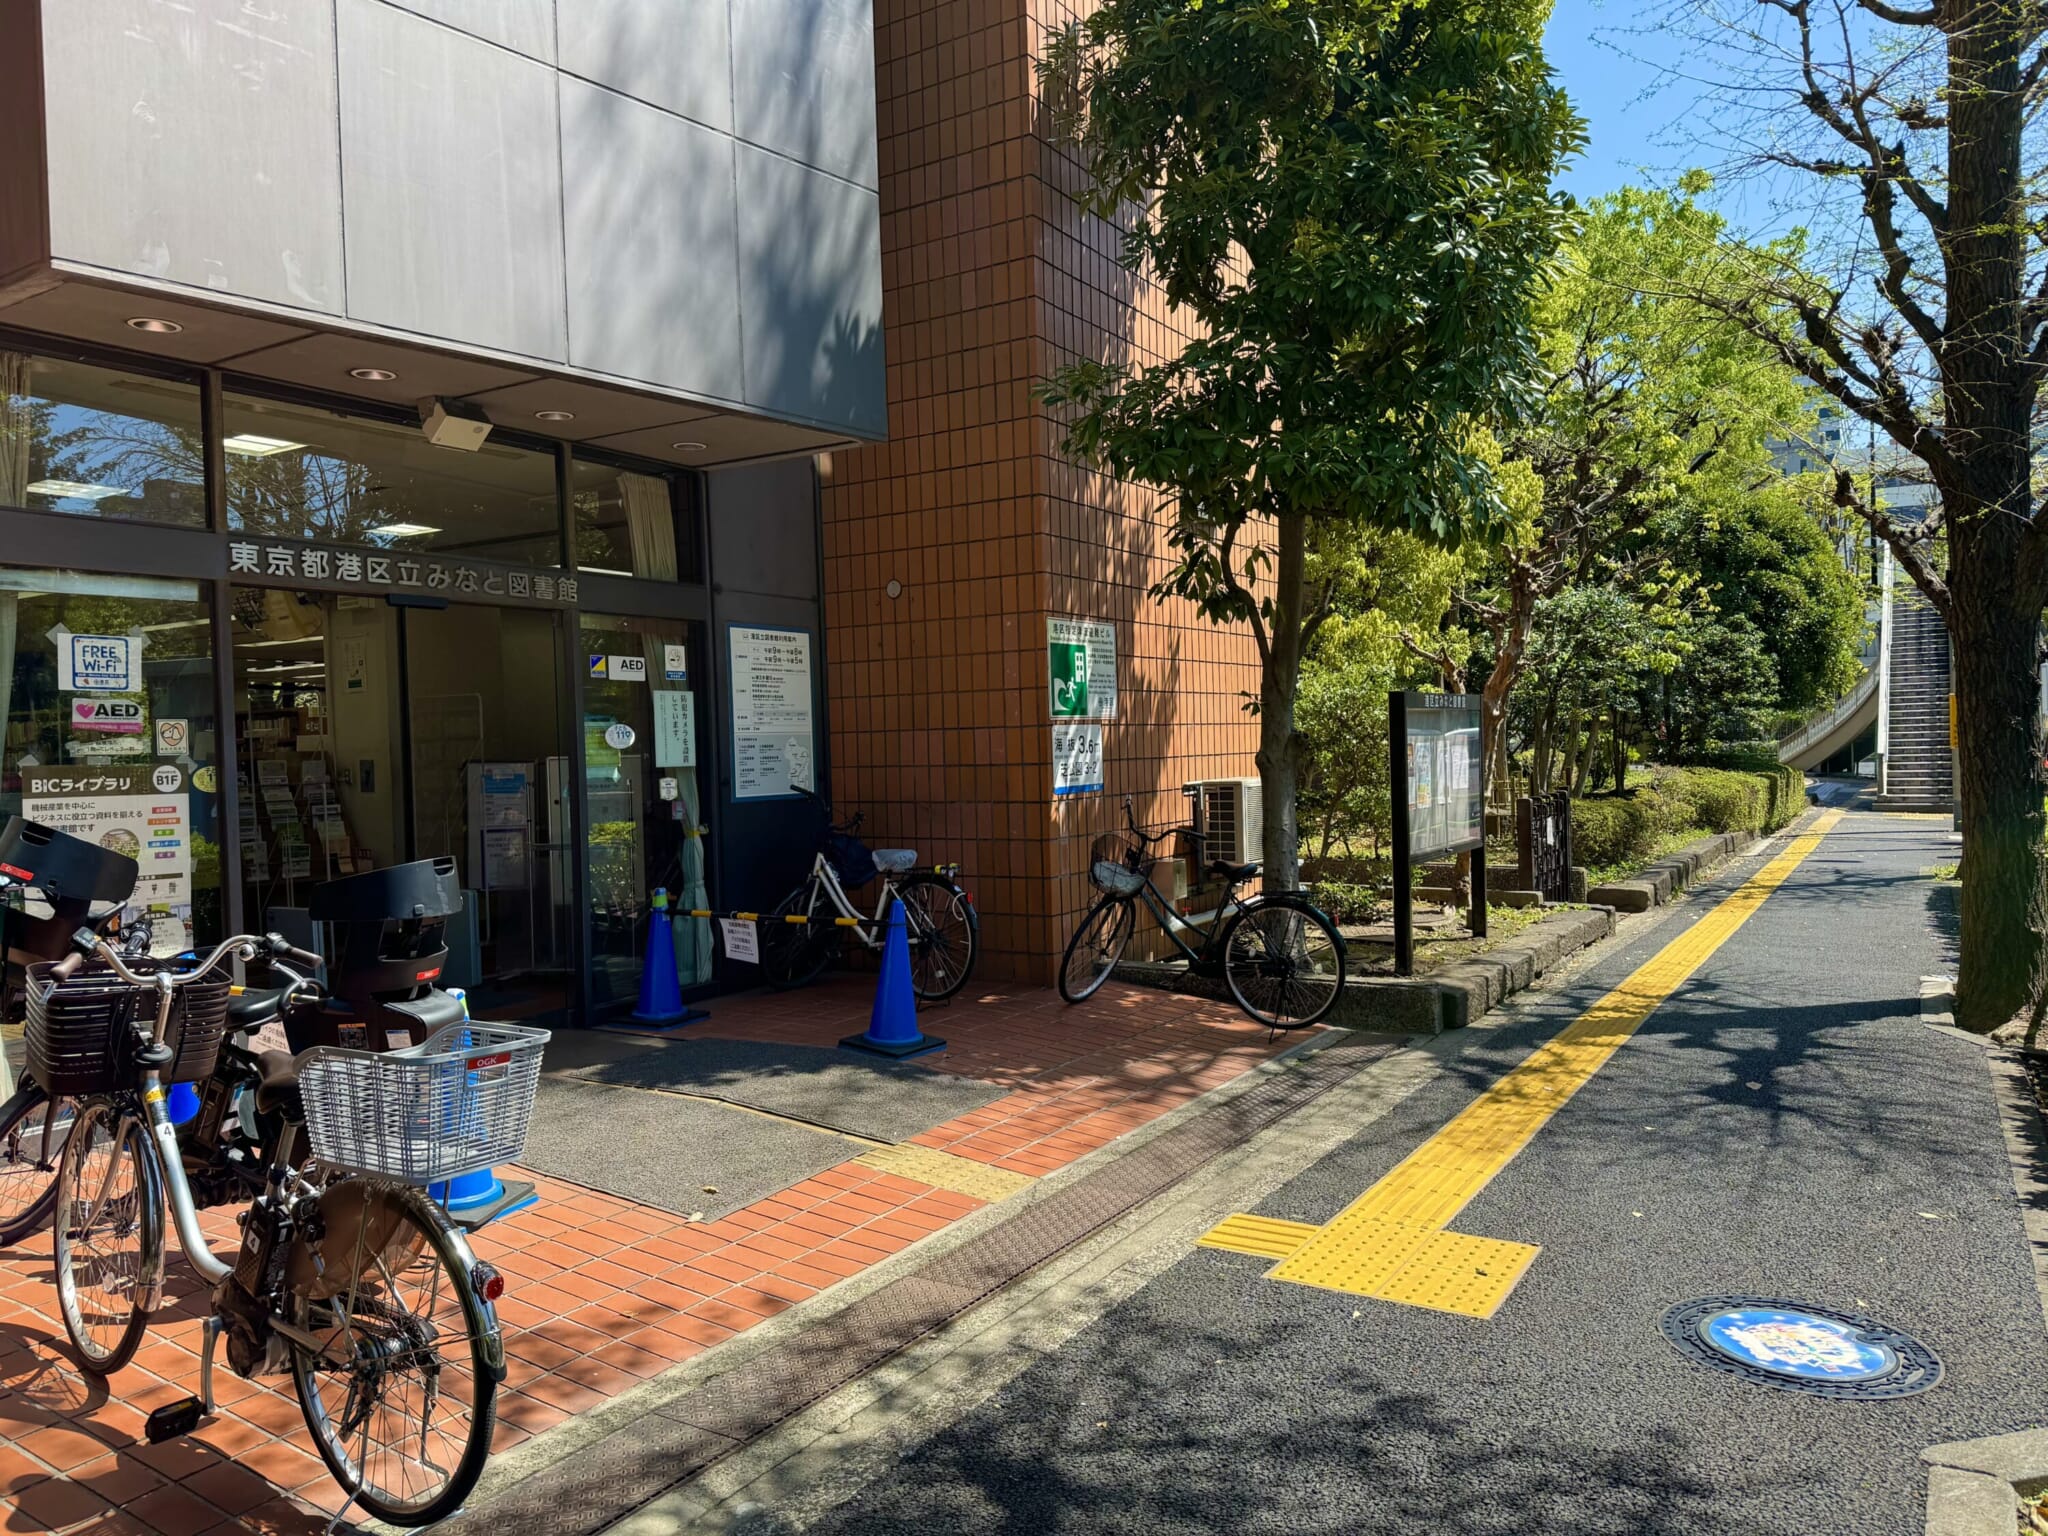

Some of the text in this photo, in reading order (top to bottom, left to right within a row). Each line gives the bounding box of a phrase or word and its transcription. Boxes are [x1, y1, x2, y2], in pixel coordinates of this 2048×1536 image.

[229, 542, 578, 602] 東京都港区立みなと図書館
[82, 645, 116, 658] FREE
[82, 659, 116, 672] Wi-Fi
[621, 659, 643, 670] AED
[95, 704, 139, 717] AED
[31, 775, 131, 793] BICライブラリ
[31, 802, 96, 812] 機械産業を中心に
[32, 810, 143, 823] ビジネスに役立つ資料を揃える
[476, 1056, 498, 1067] OGK
[163, 1125, 172, 1136] 4
